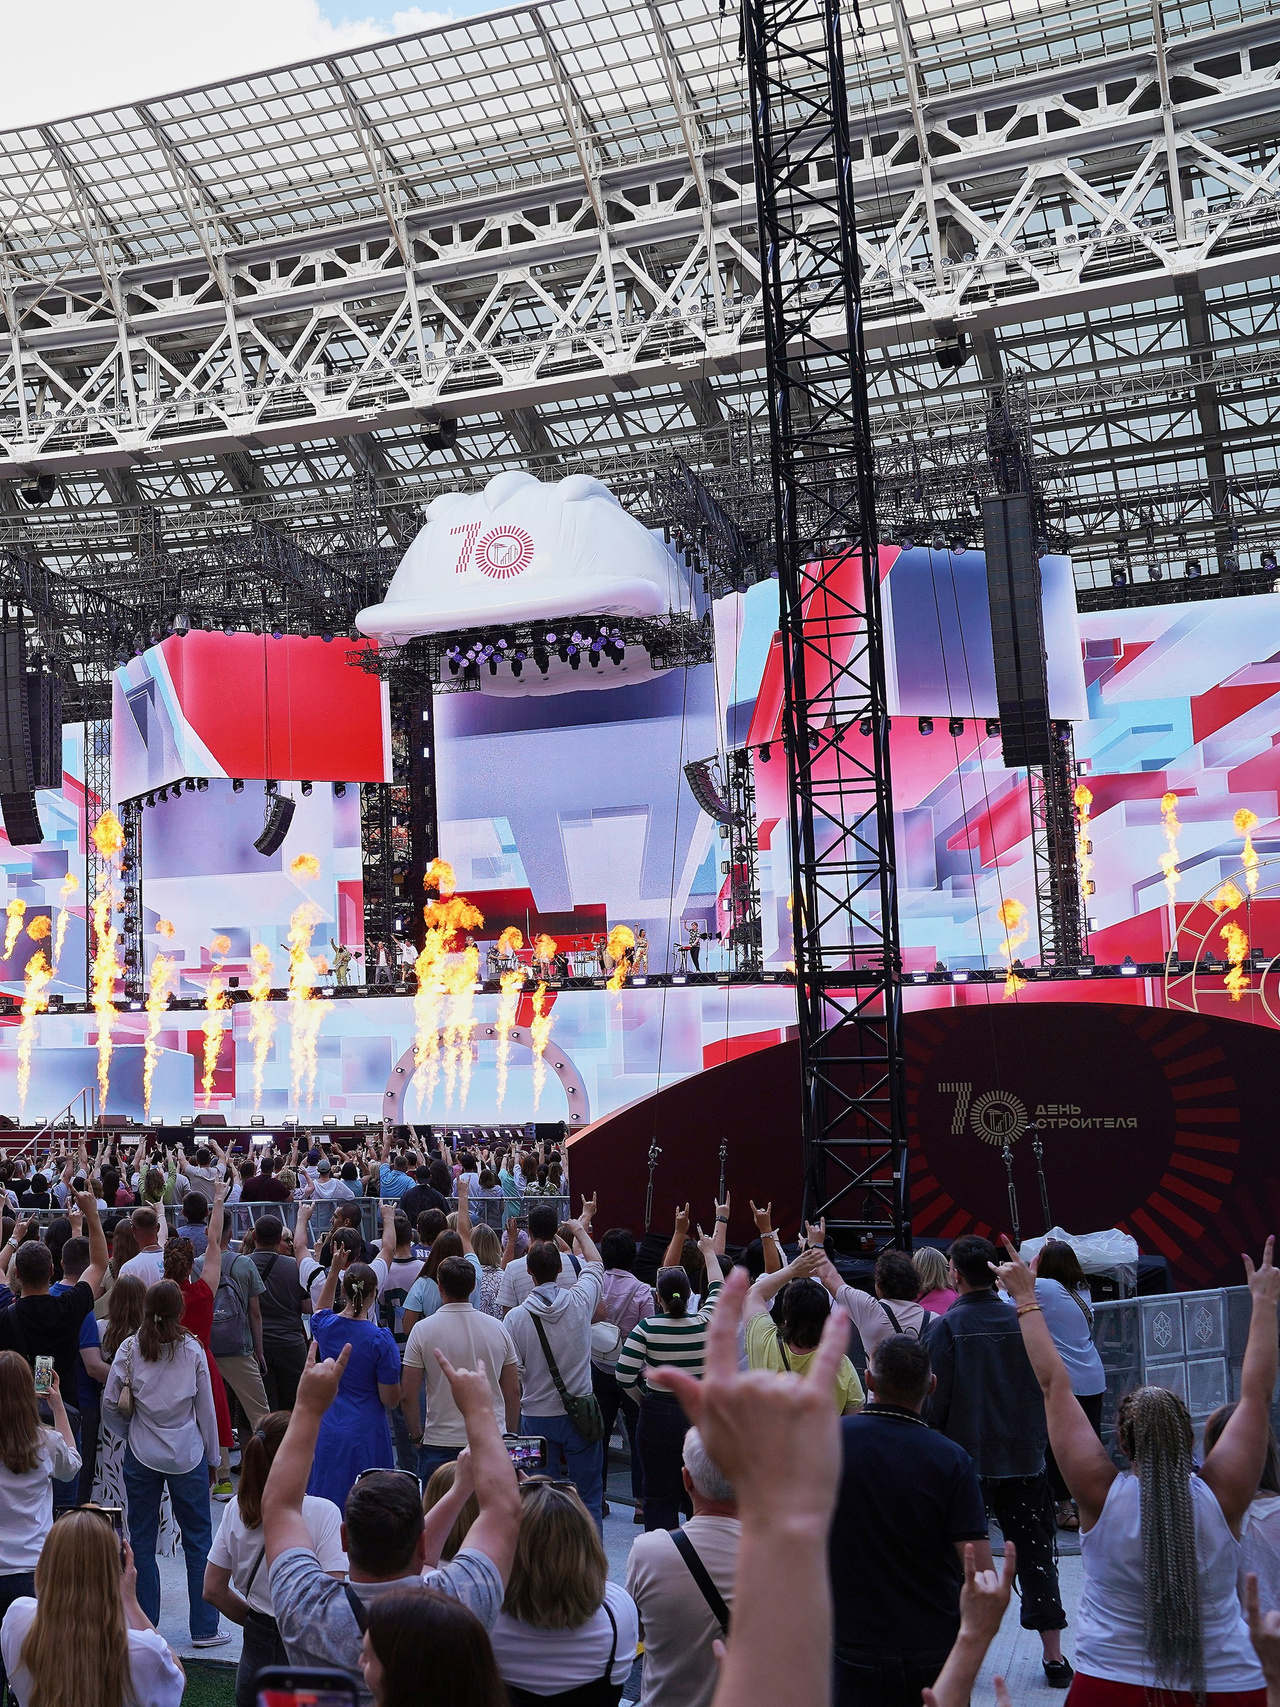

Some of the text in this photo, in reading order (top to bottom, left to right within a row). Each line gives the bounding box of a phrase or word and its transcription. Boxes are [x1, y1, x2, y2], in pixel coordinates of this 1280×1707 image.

[938, 1082, 1029, 1146] 70
[1035, 1104, 1082, 1115] ДЕНЬ
[1035, 1118, 1138, 1129] СТРОИТЕЛЯ
